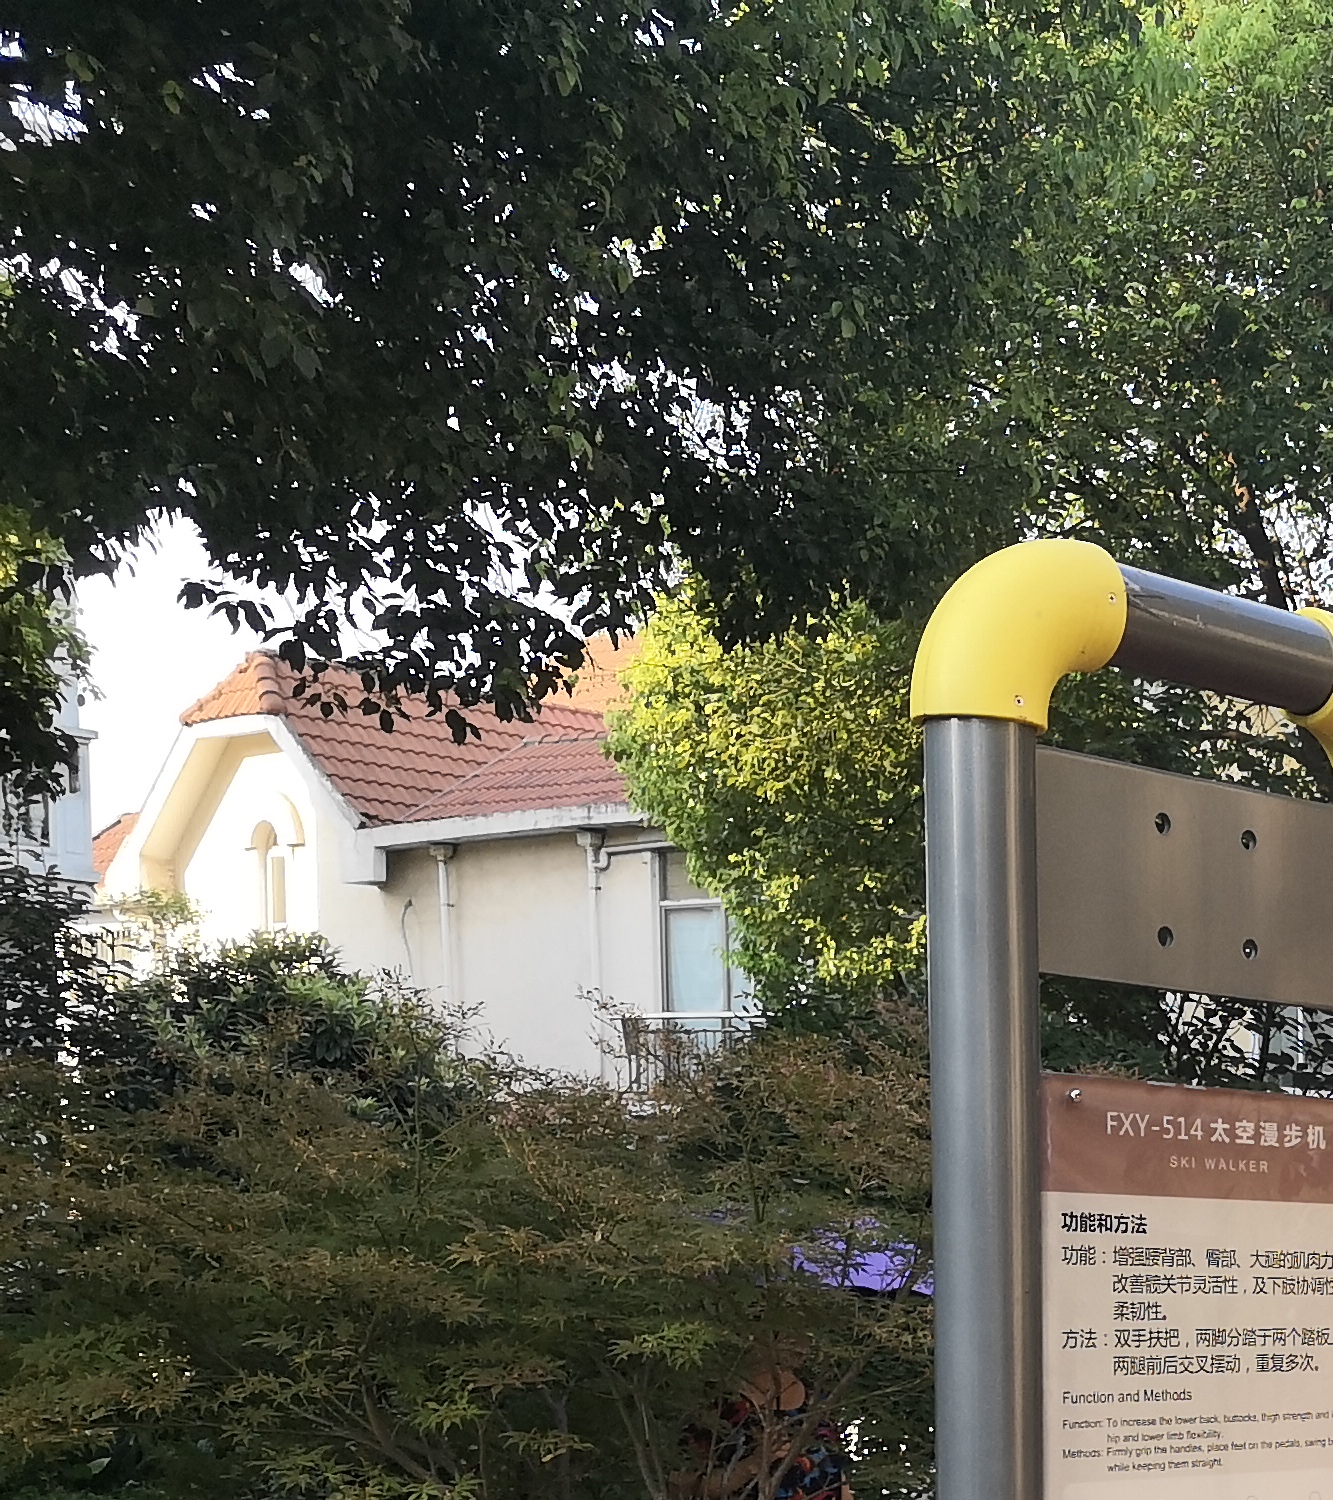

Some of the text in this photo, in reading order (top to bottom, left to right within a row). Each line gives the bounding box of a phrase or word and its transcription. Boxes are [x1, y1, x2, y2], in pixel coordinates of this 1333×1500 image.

[1169, 1155, 1269, 1173] SKI WALKER
[1061, 1211, 1148, 1235] 功能和方法
[1112, 1301, 1168, 1321] 柔韧性。
[1062, 1390, 1114, 1404] Function
[1143, 1387, 1192, 1401] Methods
